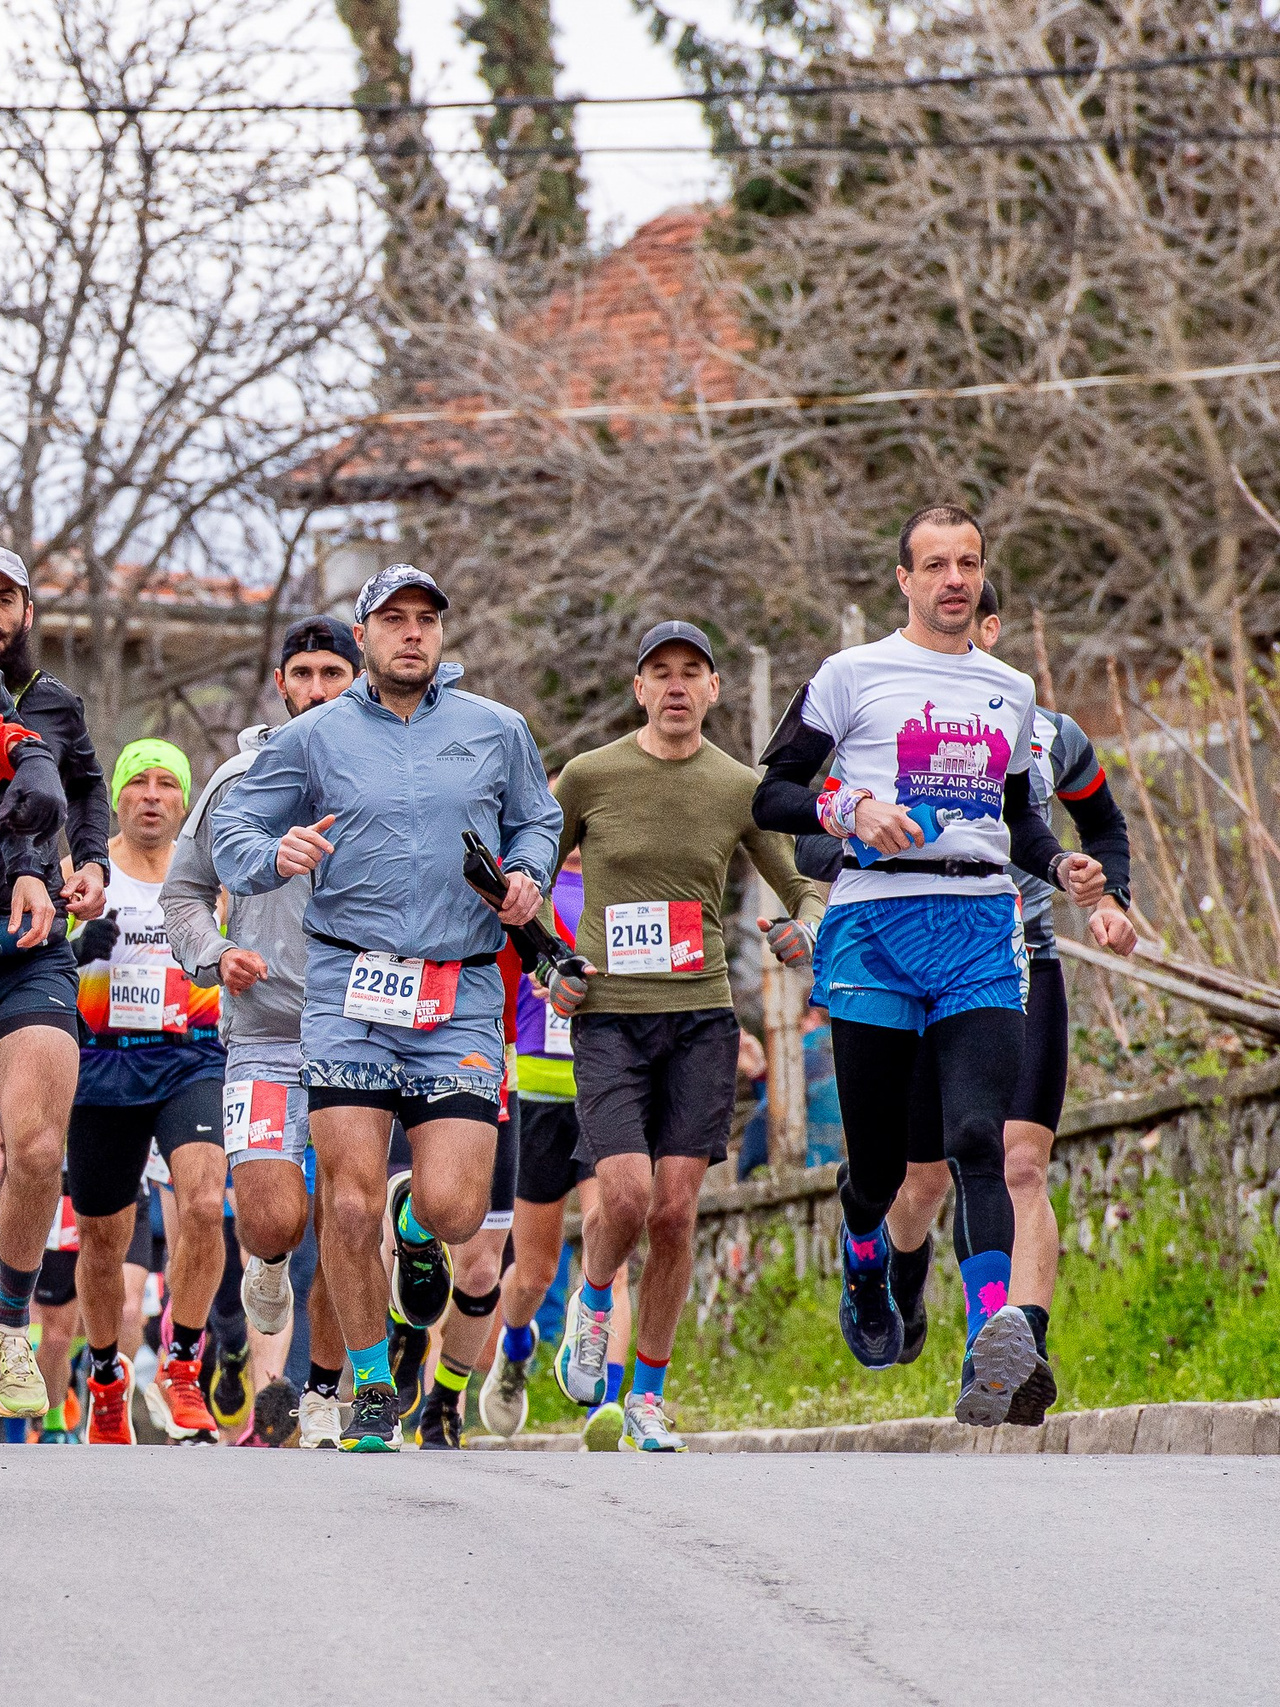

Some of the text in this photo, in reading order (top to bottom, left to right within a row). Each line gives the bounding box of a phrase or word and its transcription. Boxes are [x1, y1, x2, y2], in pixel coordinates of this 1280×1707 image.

[910, 774, 1001, 795] WIZZ AIR SOFIA
[910, 787, 977, 800] MARATHON
[612, 923, 663, 947] 2143
[389, 954, 402, 964] 22
[351, 967, 415, 998] 2286
[417, 999, 440, 1008] EVERY
[417, 1007, 436, 1017] STEP
